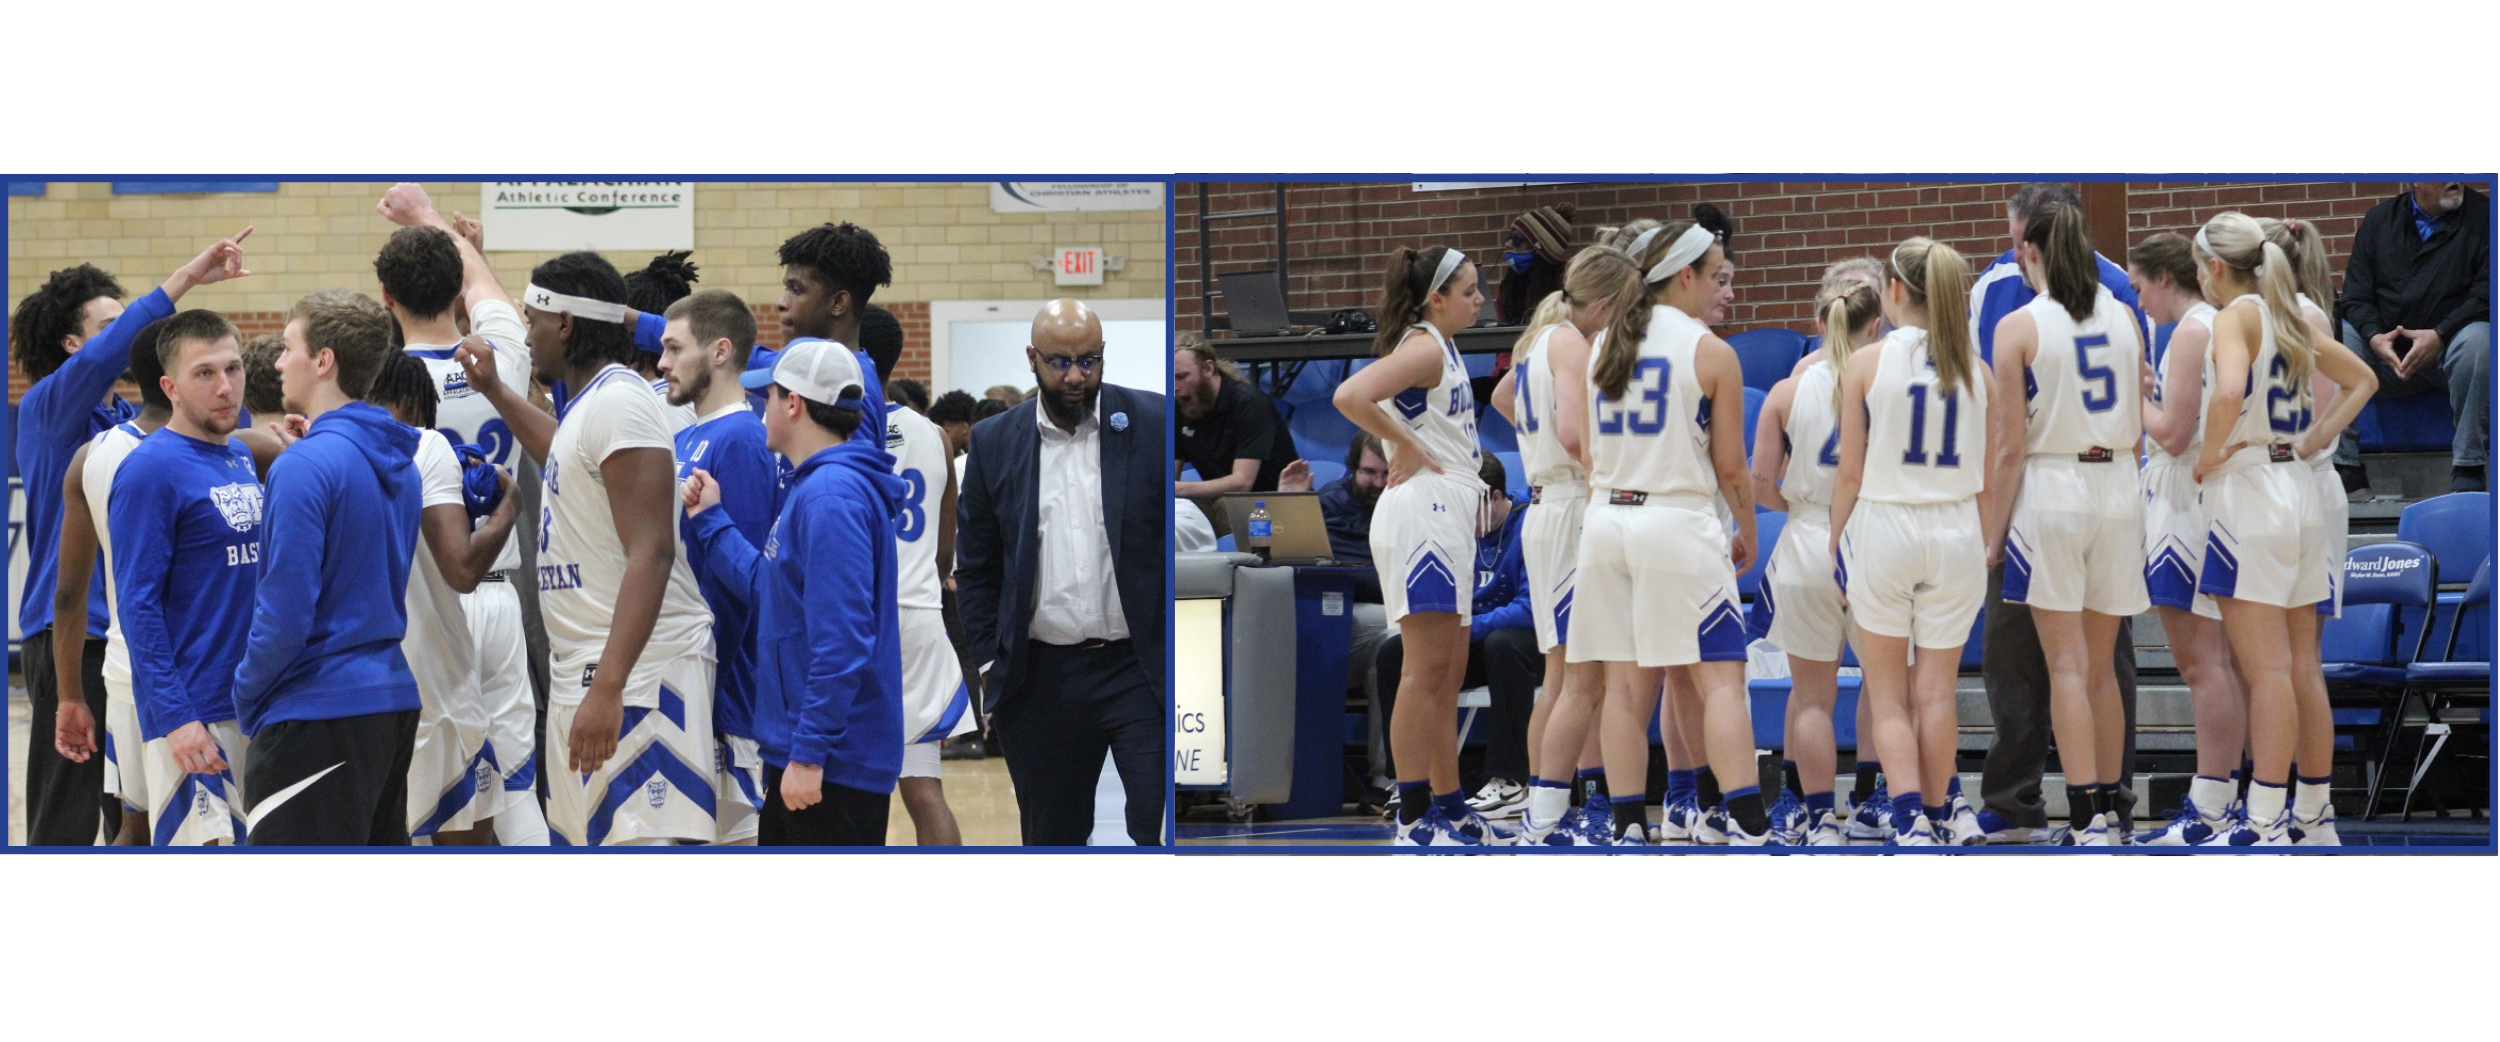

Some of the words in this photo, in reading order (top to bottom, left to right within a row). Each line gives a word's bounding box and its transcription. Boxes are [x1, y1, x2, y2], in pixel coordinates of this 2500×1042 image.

[496, 191, 569, 203] Athletic
[577, 190, 681, 206] Conference
[1095, 188, 1151, 196] ATHLETES
[1065, 250, 1094, 274] EXIT
[2074, 333, 2118, 413] 5
[1902, 382, 1961, 468] 11
[226, 542, 260, 567] BAS
[2381, 556, 2420, 572] Jones
[538, 563, 582, 591] EYAN
